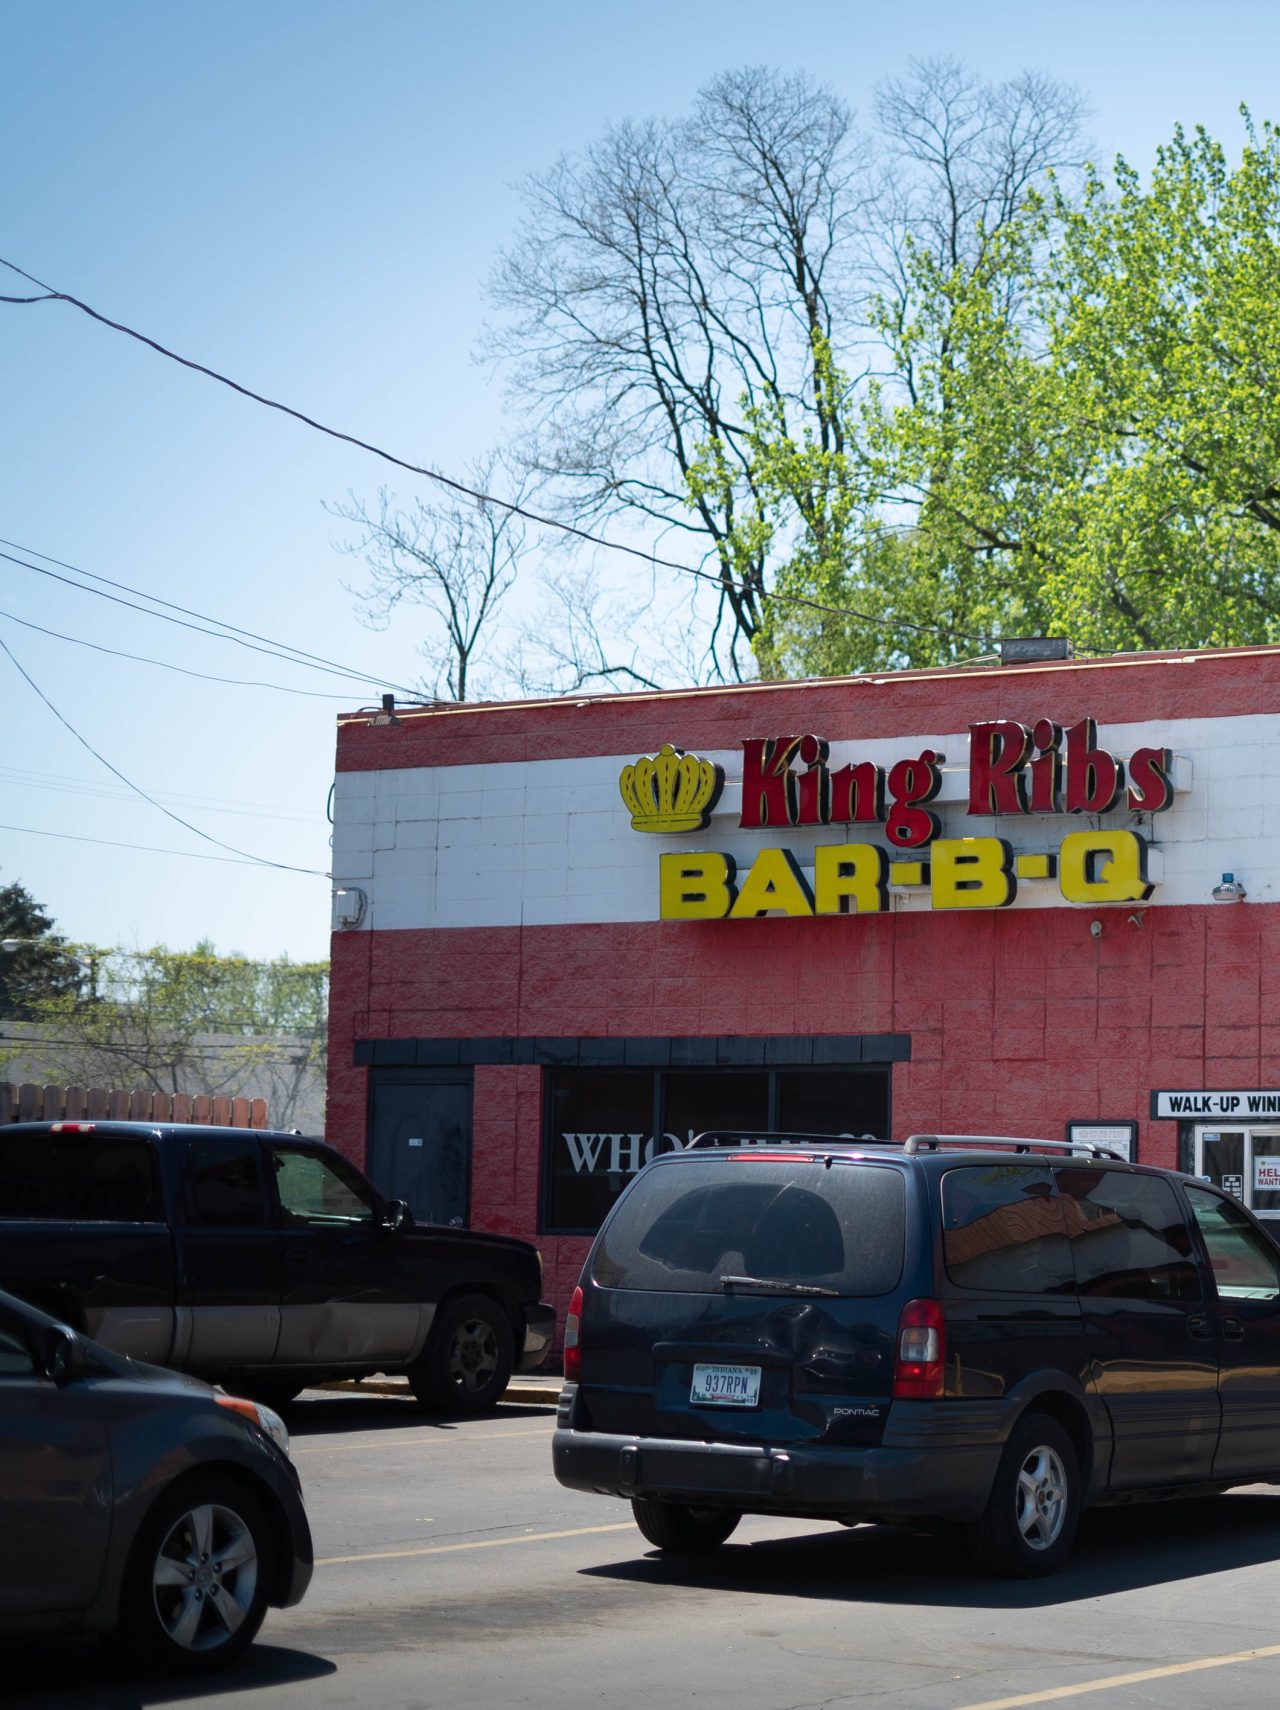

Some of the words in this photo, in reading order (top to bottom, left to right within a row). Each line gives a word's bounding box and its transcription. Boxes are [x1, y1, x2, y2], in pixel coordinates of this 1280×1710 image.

[739, 734, 945, 848] King
[967, 717, 1174, 817] Ribs
[660, 829, 1155, 920] BAR-B-Q
[1168, 1095, 1240, 1113] WALK-UP
[562, 1128, 720, 1173] WHO'
[712, 1366, 743, 1374] INDIANA
[705, 1374, 748, 1394] 937RPN
[833, 1407, 880, 1417] PONTIAC
